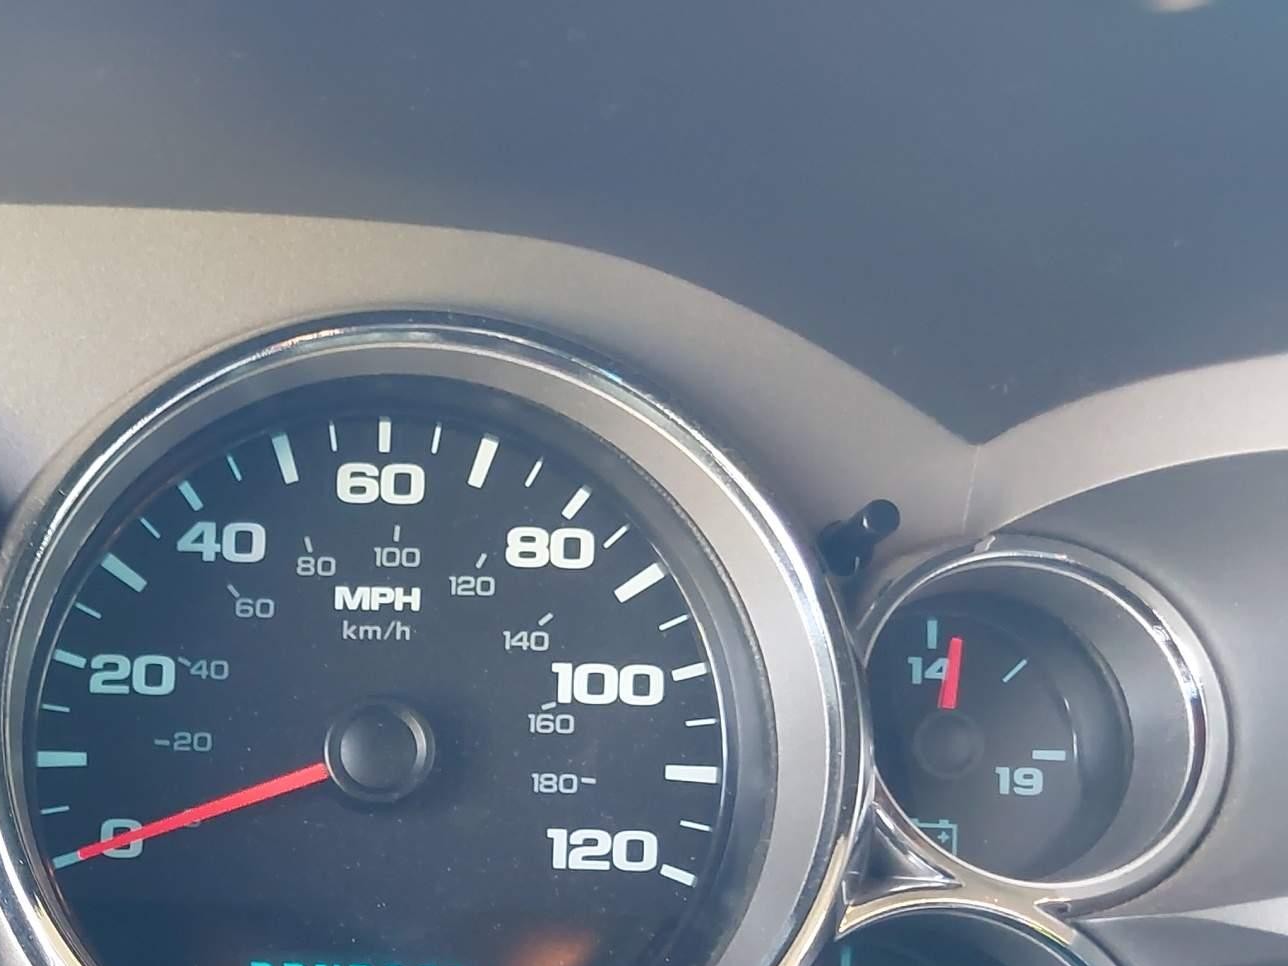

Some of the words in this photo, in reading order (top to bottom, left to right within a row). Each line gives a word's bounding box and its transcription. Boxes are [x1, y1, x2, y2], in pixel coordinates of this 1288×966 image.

[337, 462, 425, 504] 60
[177, 522, 266, 563] 40
[505, 527, 594, 569] 80
[296, 556, 336, 577] 80
[374, 547, 420, 568] 100
[449, 576, 495, 597] 120
[235, 597, 275, 619] 60
[334, 586, 421, 611] MPH
[341, 620, 411, 642] km/h
[503, 630, 549, 651] 140
[89, 655, 175, 695] 20
[189, 661, 229, 680] 40
[908, 656, 949, 684] 14
[552, 663, 664, 705] 100
[528, 714, 574, 735] 160
[172, 732, 212, 752] 20
[531, 772, 577, 793] 180
[995, 766, 1043, 795] 19
[100, 818, 143, 858] 0
[547, 828, 658, 871] 120
